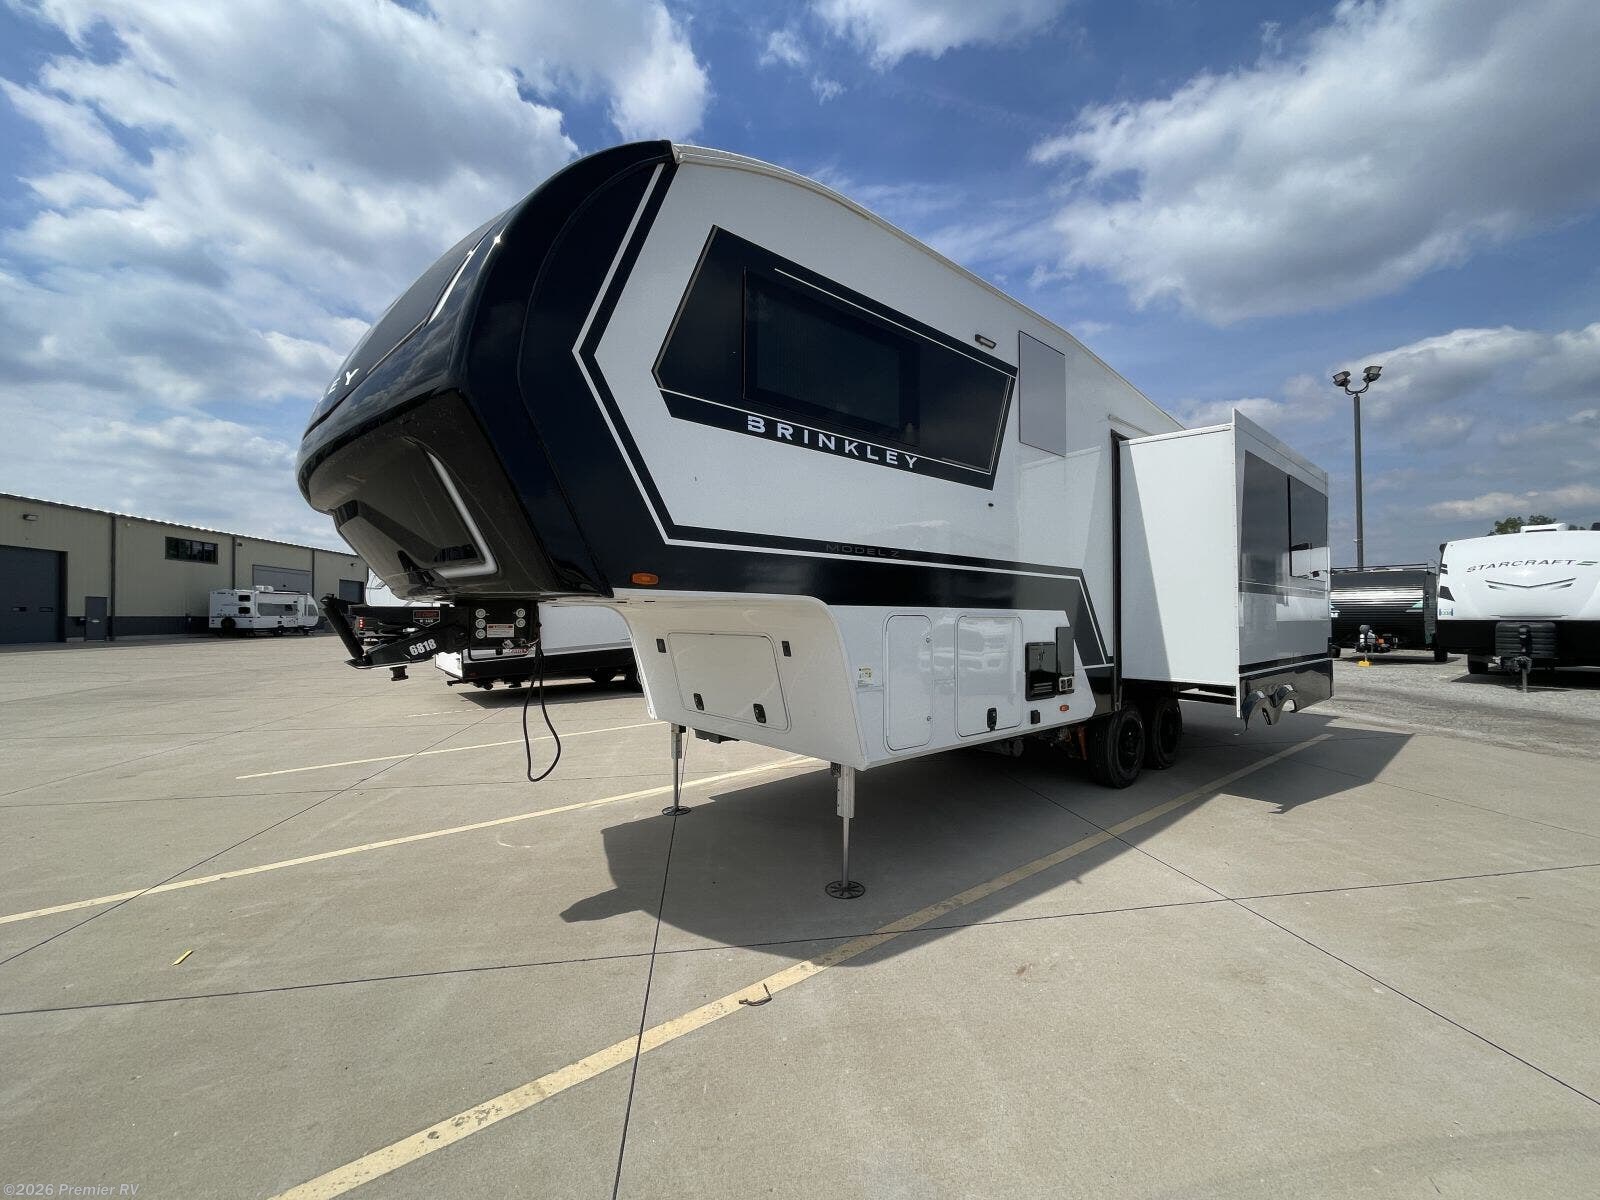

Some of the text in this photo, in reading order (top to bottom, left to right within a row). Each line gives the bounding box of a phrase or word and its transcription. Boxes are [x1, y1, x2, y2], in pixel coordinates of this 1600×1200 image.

[747, 415, 918, 469] BRINKLEY
[826, 543, 887, 557] MODEL
[1466, 559, 1577, 573] STARCRAFT
[409, 638, 437, 656] 6818
